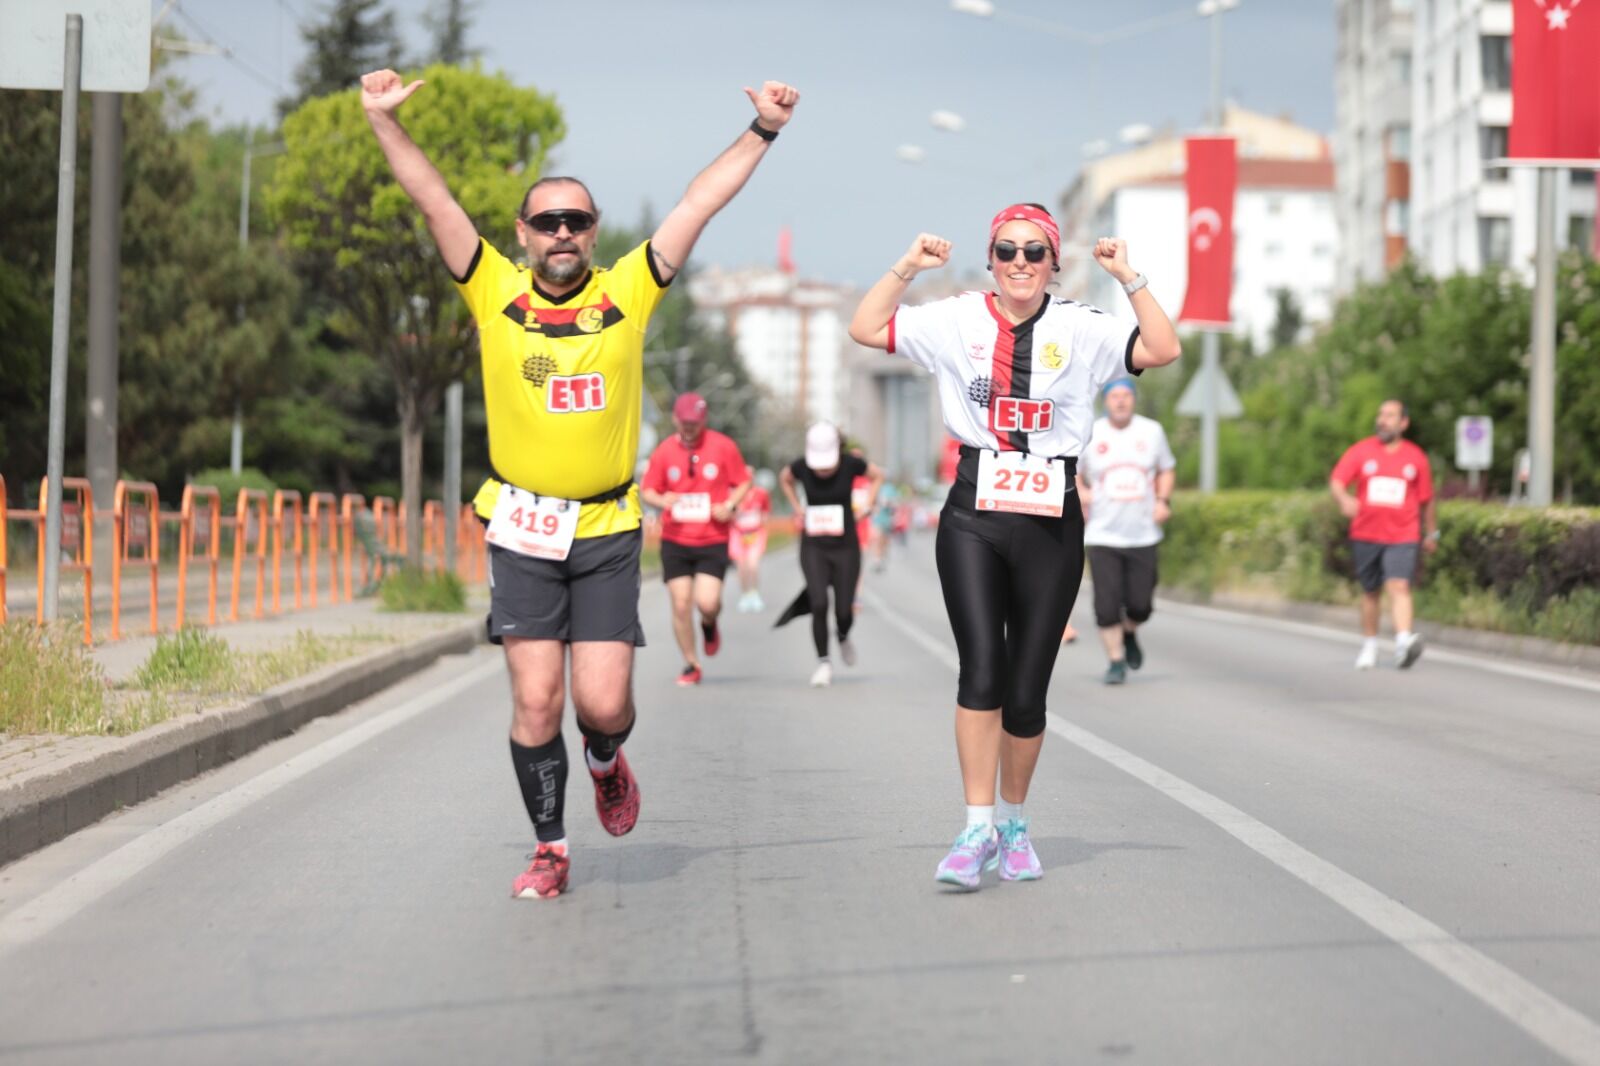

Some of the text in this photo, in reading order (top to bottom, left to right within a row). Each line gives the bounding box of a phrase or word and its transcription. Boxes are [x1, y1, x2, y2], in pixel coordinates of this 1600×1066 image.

[993, 468, 1050, 494] 279
[509, 506, 559, 536] 419
[527, 759, 560, 823] kalenji
